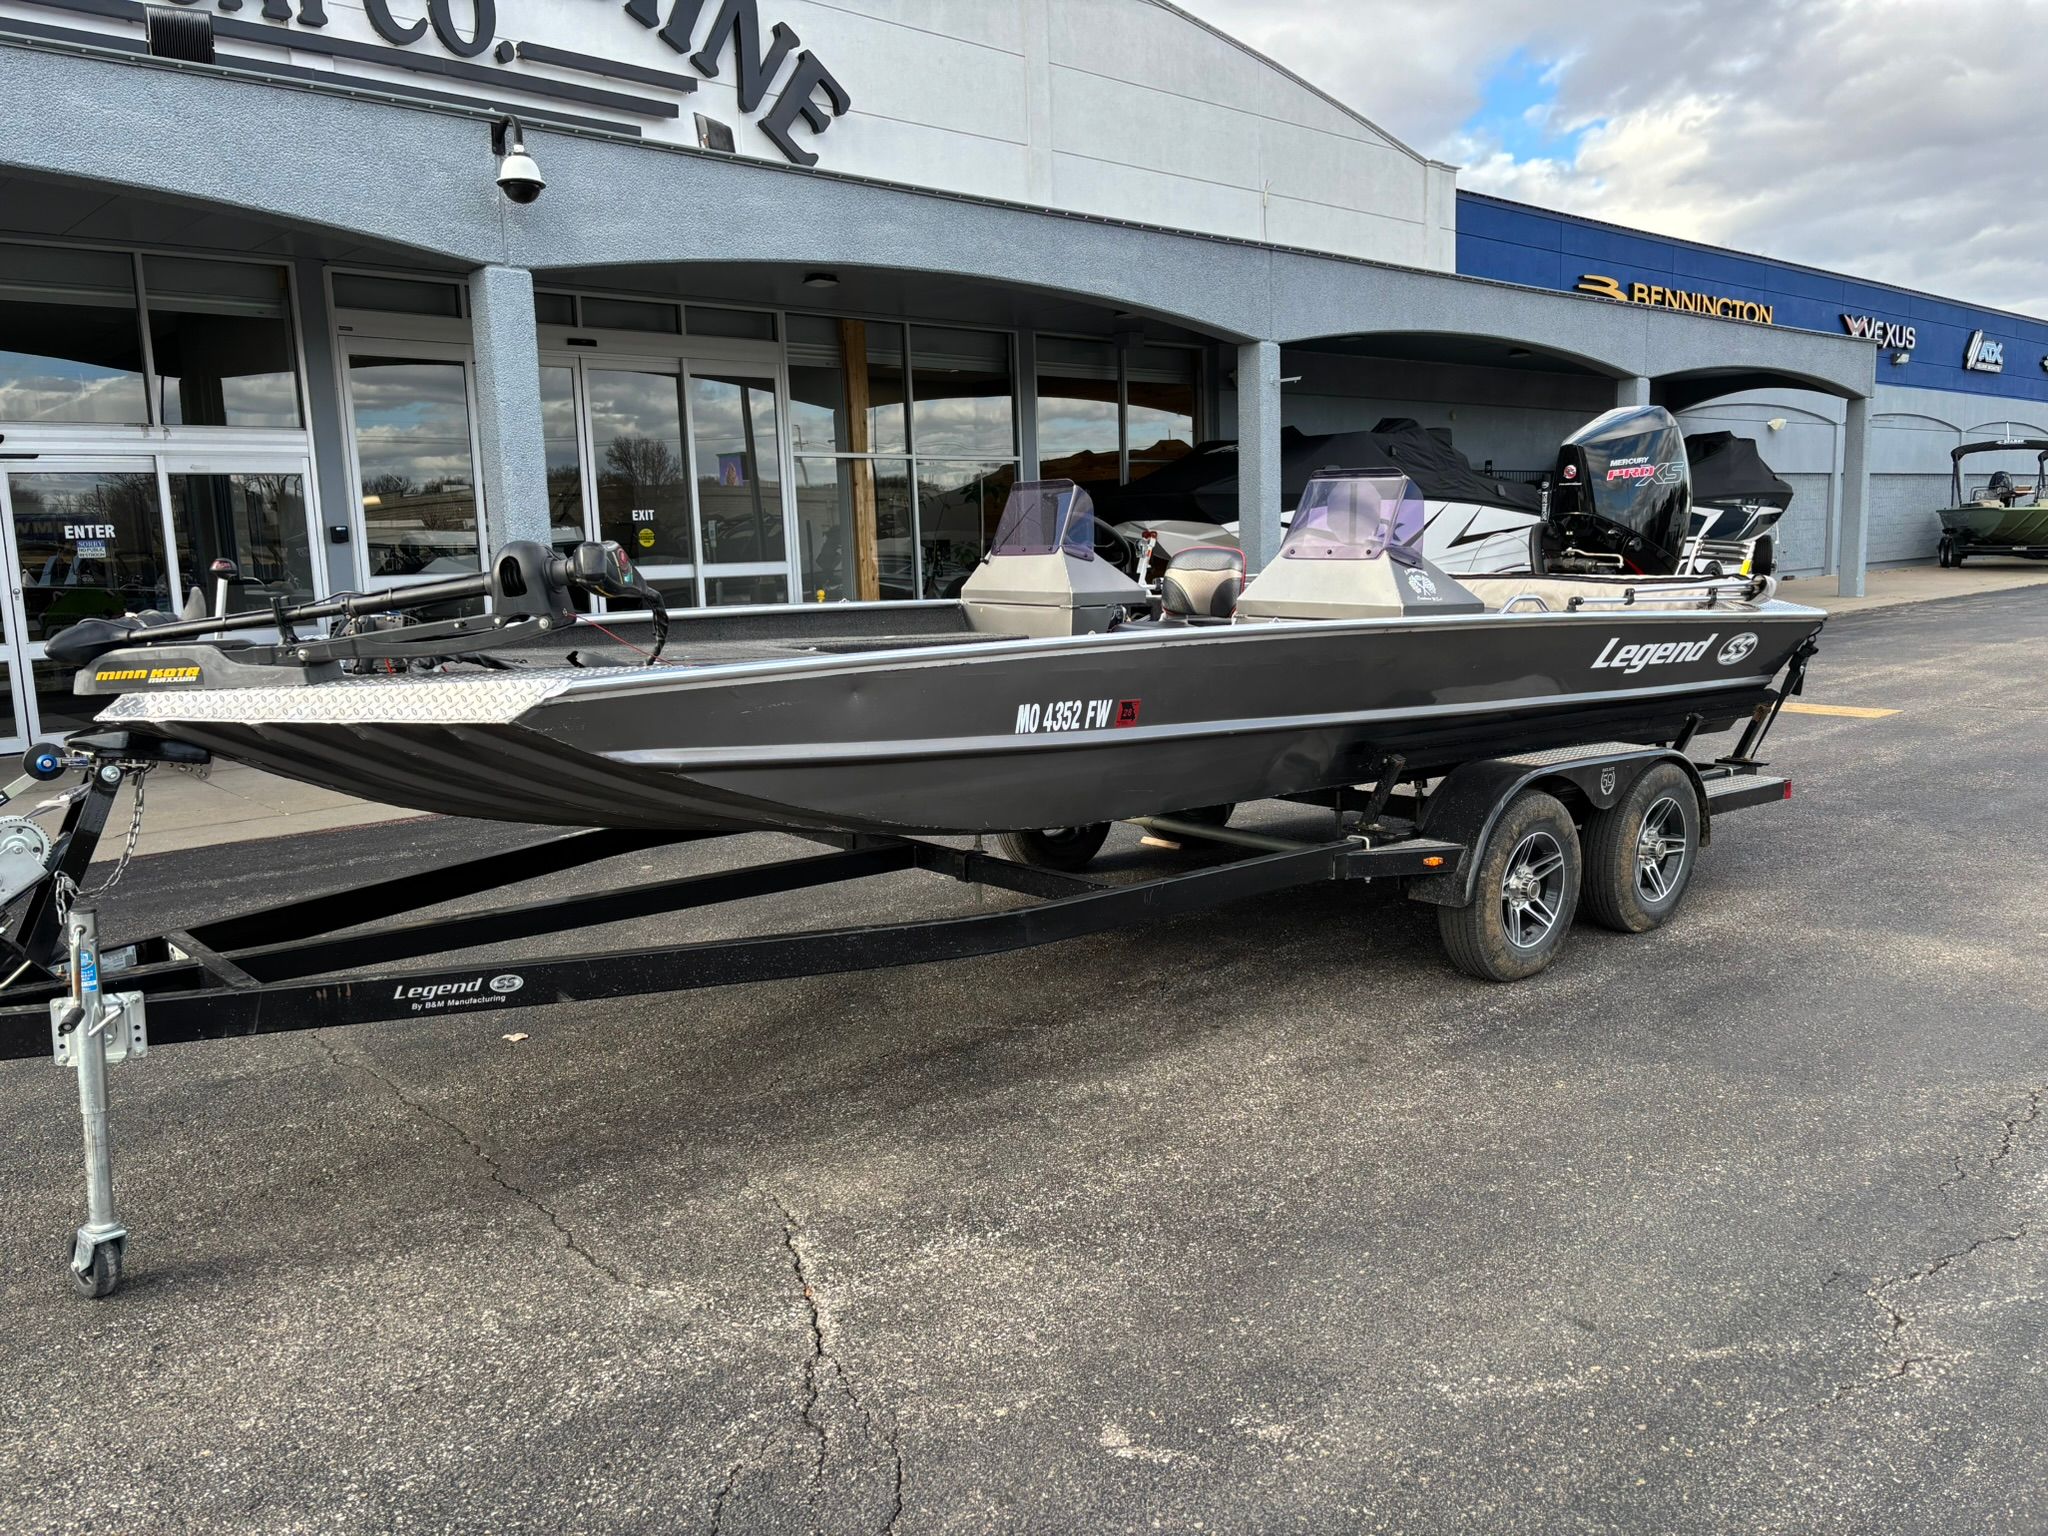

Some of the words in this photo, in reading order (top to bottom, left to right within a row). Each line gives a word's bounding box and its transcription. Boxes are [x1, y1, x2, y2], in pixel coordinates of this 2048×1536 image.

[1631, 281, 1774, 325] BENNINGTON
[1863, 315, 1916, 350] VEXUS
[1610, 457, 1649, 467] MERCURY
[632, 510, 655, 521] EXIT
[64, 525, 116, 539] ENTER
[1590, 633, 1719, 674] Legend
[150, 666, 201, 678] KOTA
[1015, 703, 1041, 734] MO
[1043, 699, 1083, 732] 4352
[1084, 699, 1114, 729] FW
[393, 977, 483, 1000] Legend
[411, 1002, 423, 1011] By
[425, 999, 445, 1009] B&M
[447, 995, 506, 1007] Manufacturing
